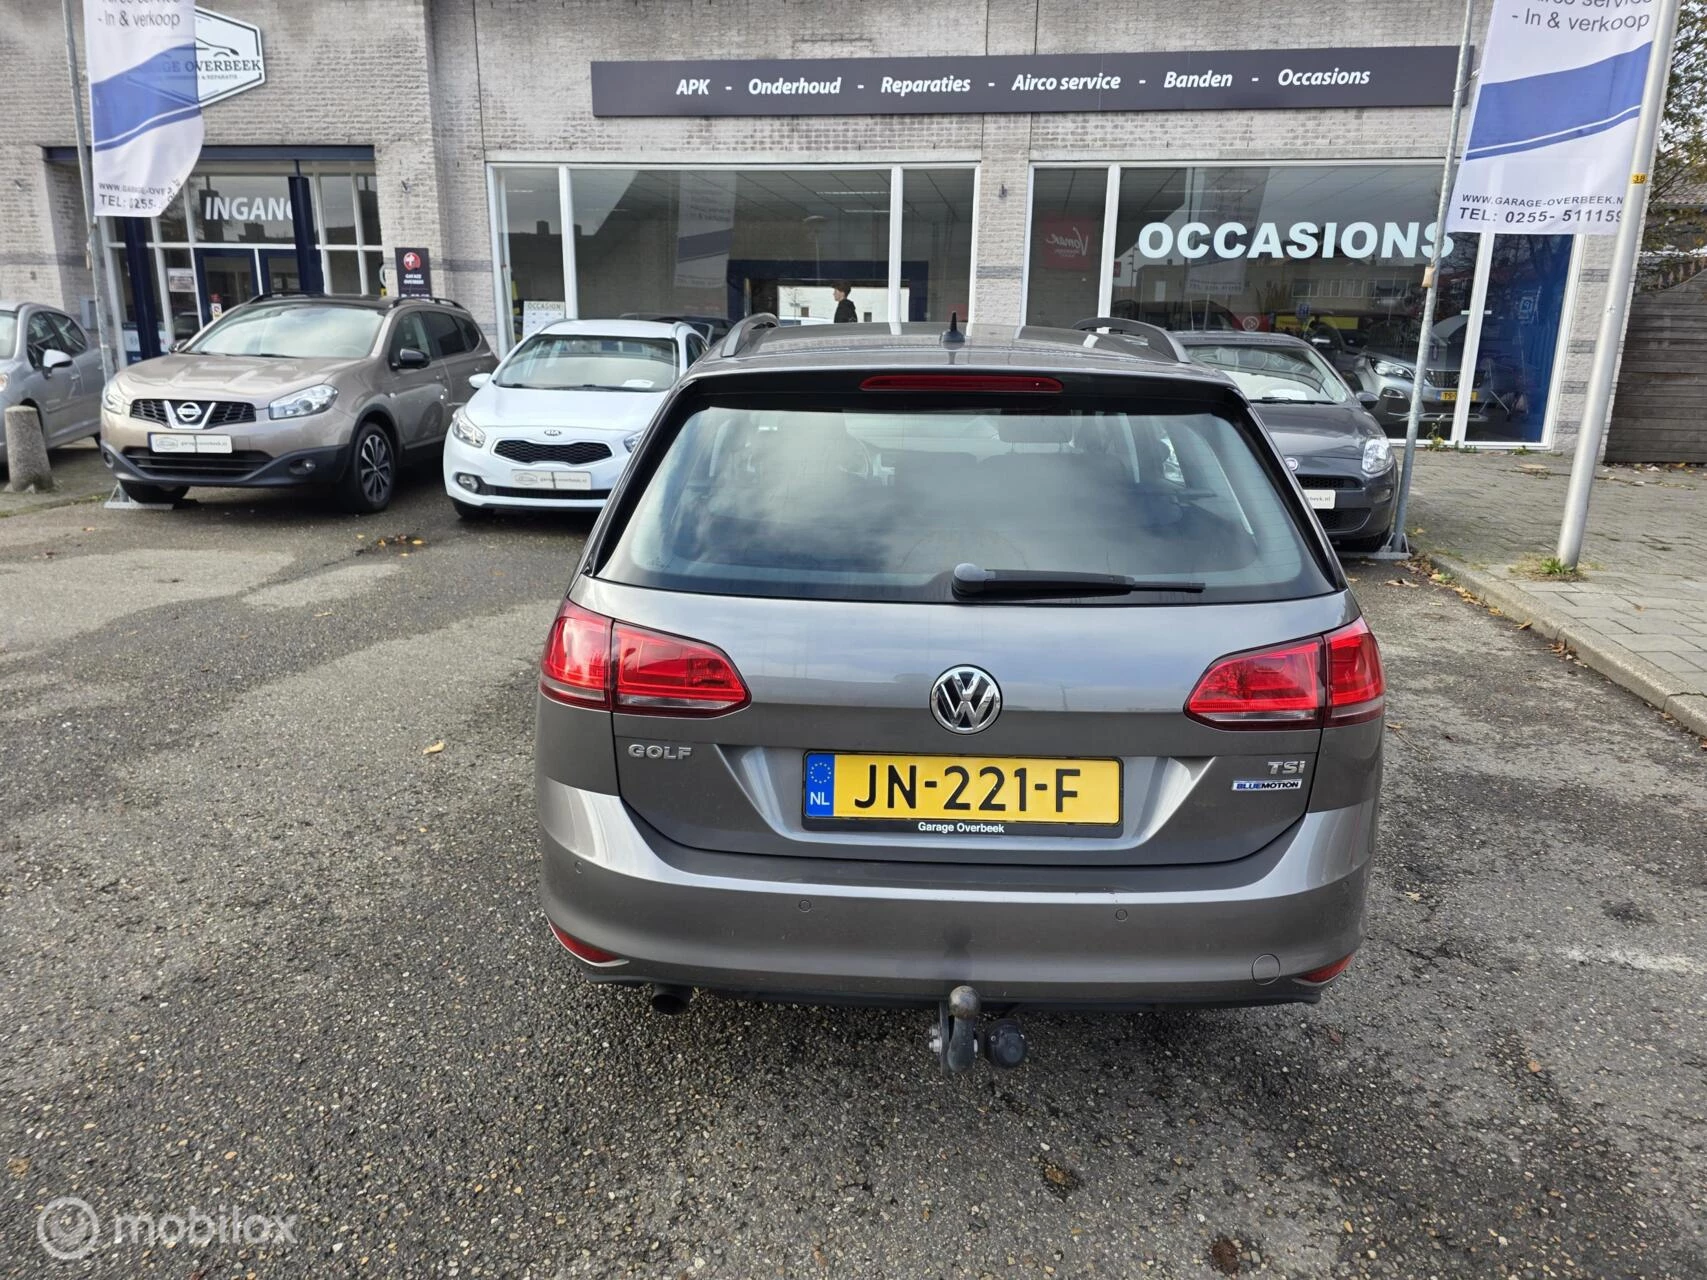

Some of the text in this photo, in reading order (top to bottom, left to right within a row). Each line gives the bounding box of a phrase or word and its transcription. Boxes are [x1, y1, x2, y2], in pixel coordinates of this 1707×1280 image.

[119, 10, 129, 27] &
[133, 10, 180, 30] verkoop
[1524, 8, 1541, 26] In
[1547, 11, 1560, 29] &
[1568, 13, 1651, 33] verkoop
[676, 79, 711, 95] APK
[748, 77, 842, 95] Onderhoud
[881, 75, 971, 97] Reparaties
[1011, 74, 1057, 91] Airco
[1059, 72, 1121, 90] service
[1163, 70, 1233, 89] Banden
[1278, 67, 1371, 86] Occasions
[99, 194, 126, 208] TEL:
[1459, 207, 1498, 222] TEL:
[1138, 221, 1454, 259] OCCASIONS
[628, 743, 692, 760] GOLF
[810, 763, 1081, 813] NL JN-221-F
[1236, 781, 1299, 790] BLUEMOTION
[918, 821, 1005, 834] Garage Overbeek
